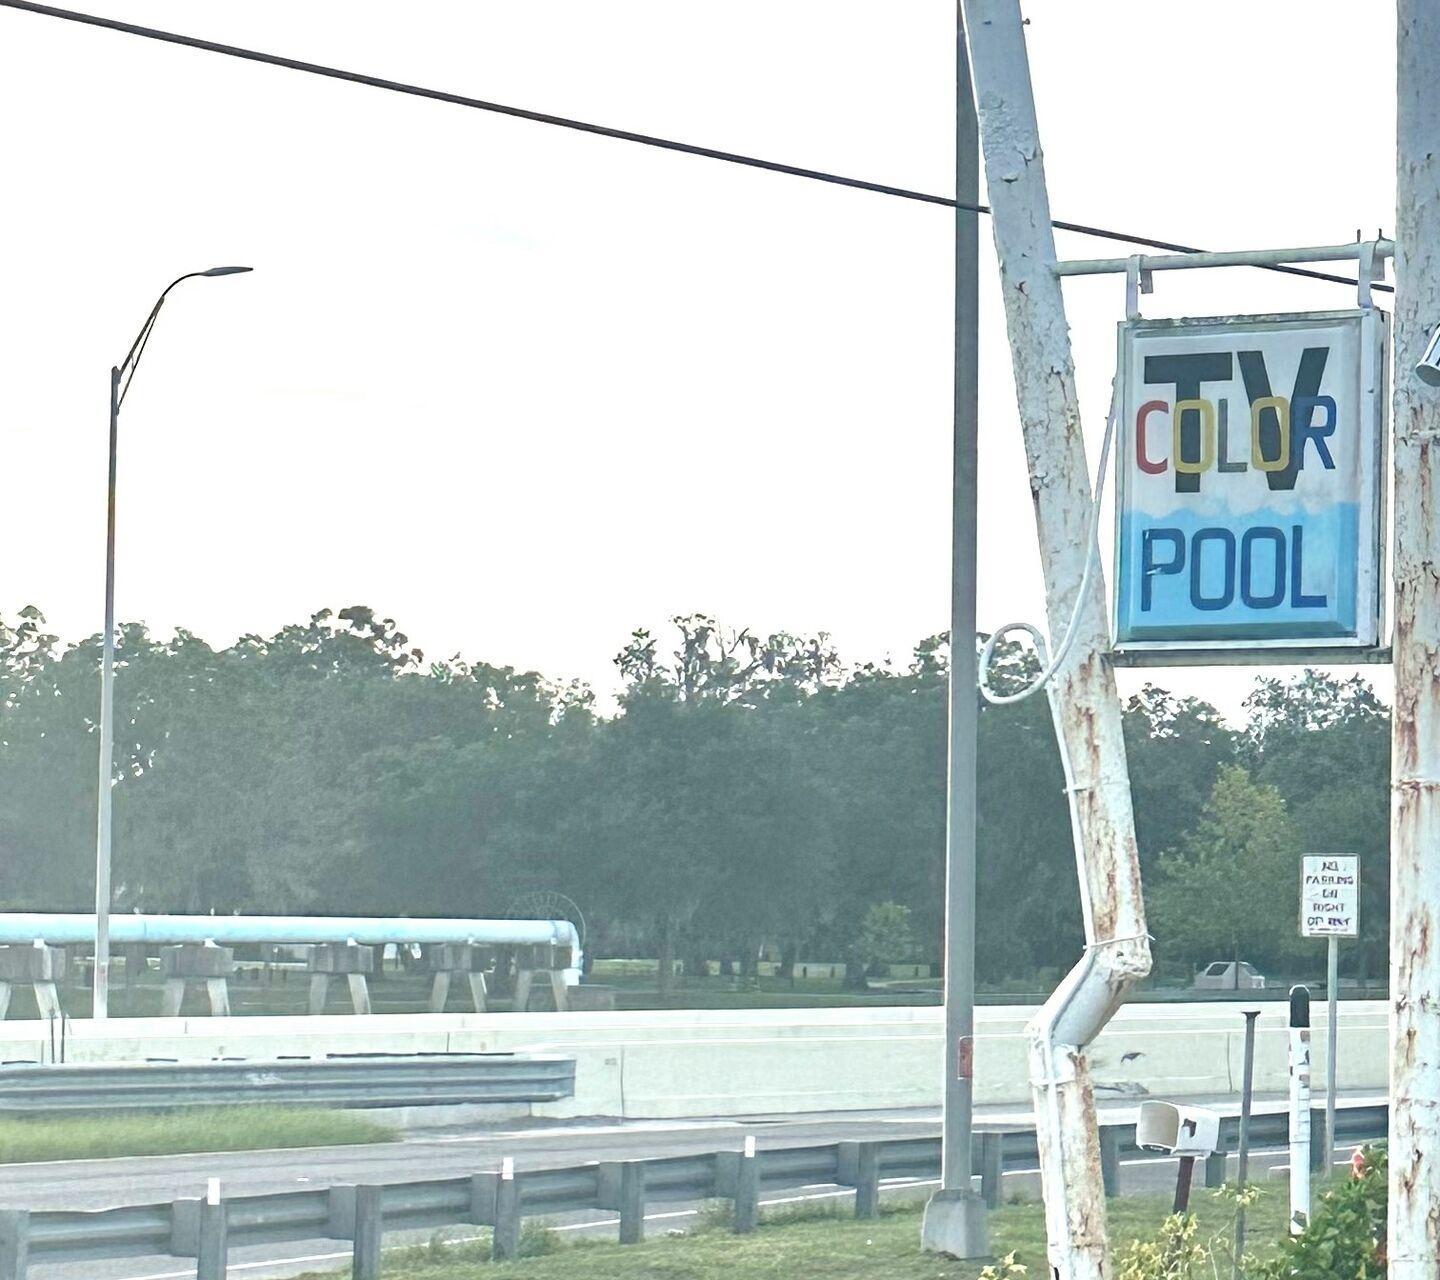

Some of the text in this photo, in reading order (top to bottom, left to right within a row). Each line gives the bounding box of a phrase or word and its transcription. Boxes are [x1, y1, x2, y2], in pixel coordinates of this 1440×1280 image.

[1136, 396, 1337, 474] COLOR
[1144, 347, 1330, 492] TV
[1141, 525, 1328, 612] POOL
